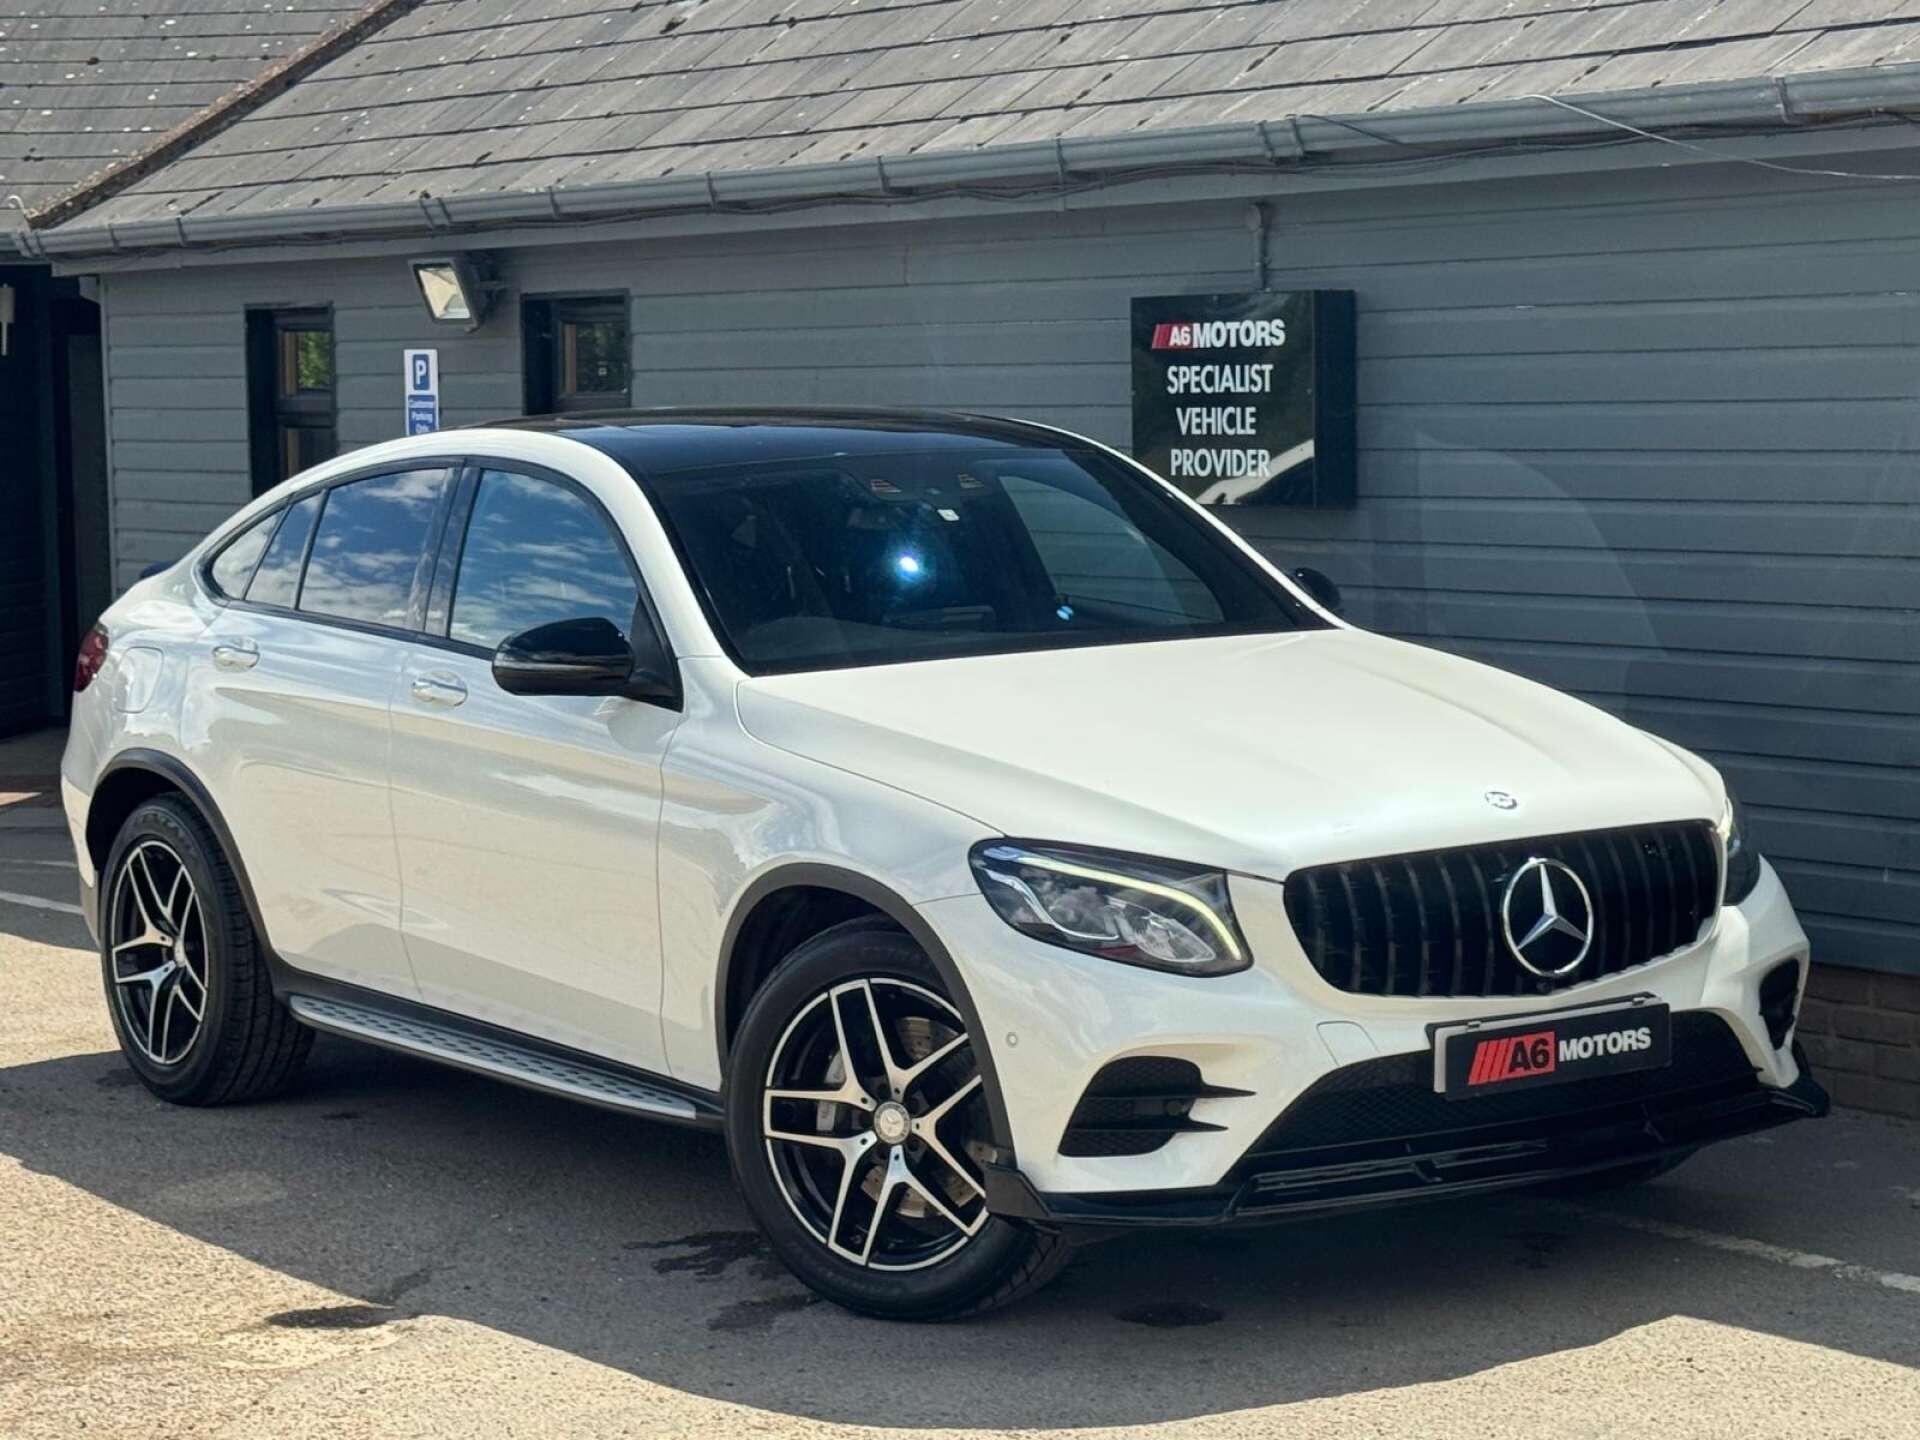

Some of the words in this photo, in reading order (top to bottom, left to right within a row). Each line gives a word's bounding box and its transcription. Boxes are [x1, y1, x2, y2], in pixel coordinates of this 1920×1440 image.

[1192, 319, 1287, 348] MOTORS
[415, 359, 427, 385] P
[1166, 364, 1274, 394] SPECIALIST
[1175, 406, 1257, 436] VEHICLE
[1170, 448, 1271, 478] PROVIDER
[1508, 1037, 1551, 1073] A6
[1558, 1026, 1653, 1063] MOTORS
